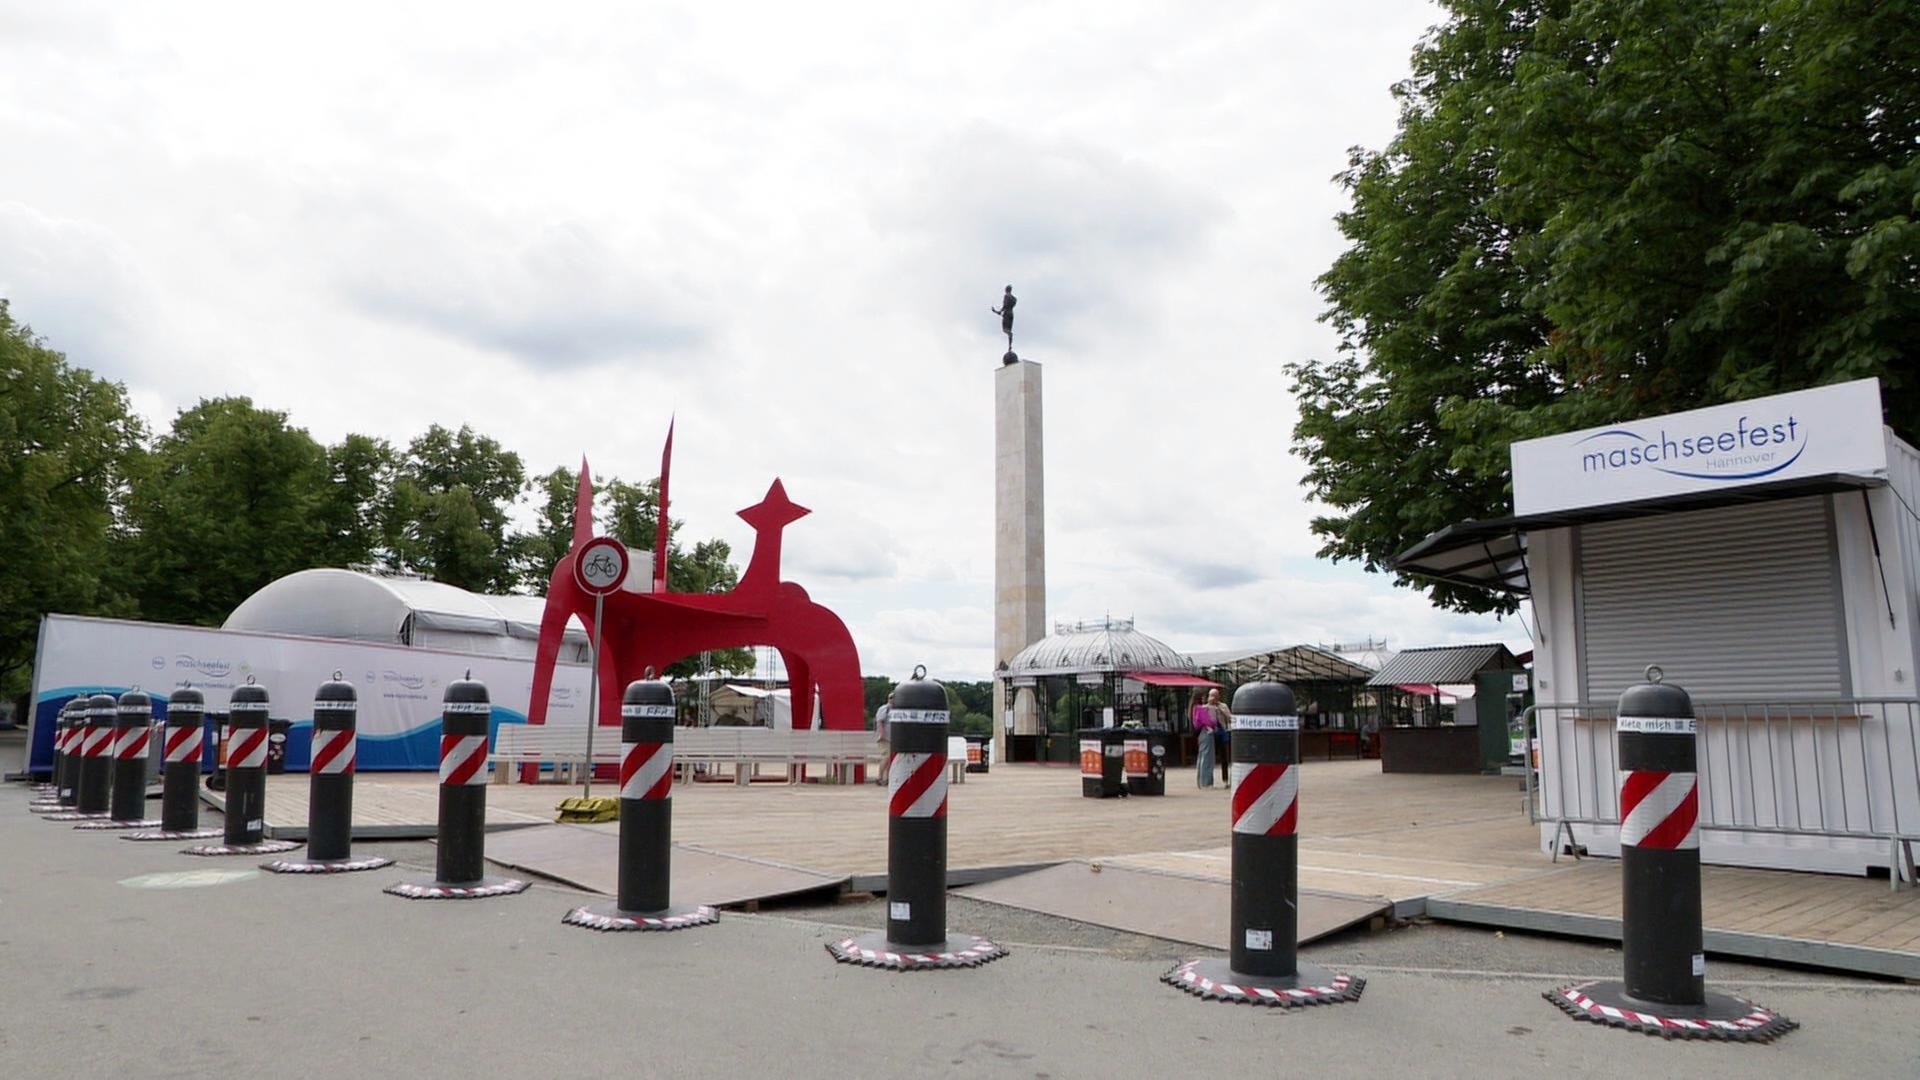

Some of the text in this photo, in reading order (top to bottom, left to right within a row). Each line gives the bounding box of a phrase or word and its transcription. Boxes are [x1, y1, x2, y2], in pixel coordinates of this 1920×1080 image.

[1583, 416, 1798, 472] maschseefest
[1706, 452, 1776, 470] Hannover
[1265, 717, 1287, 728] mich
[1645, 719, 1672, 731] mich
